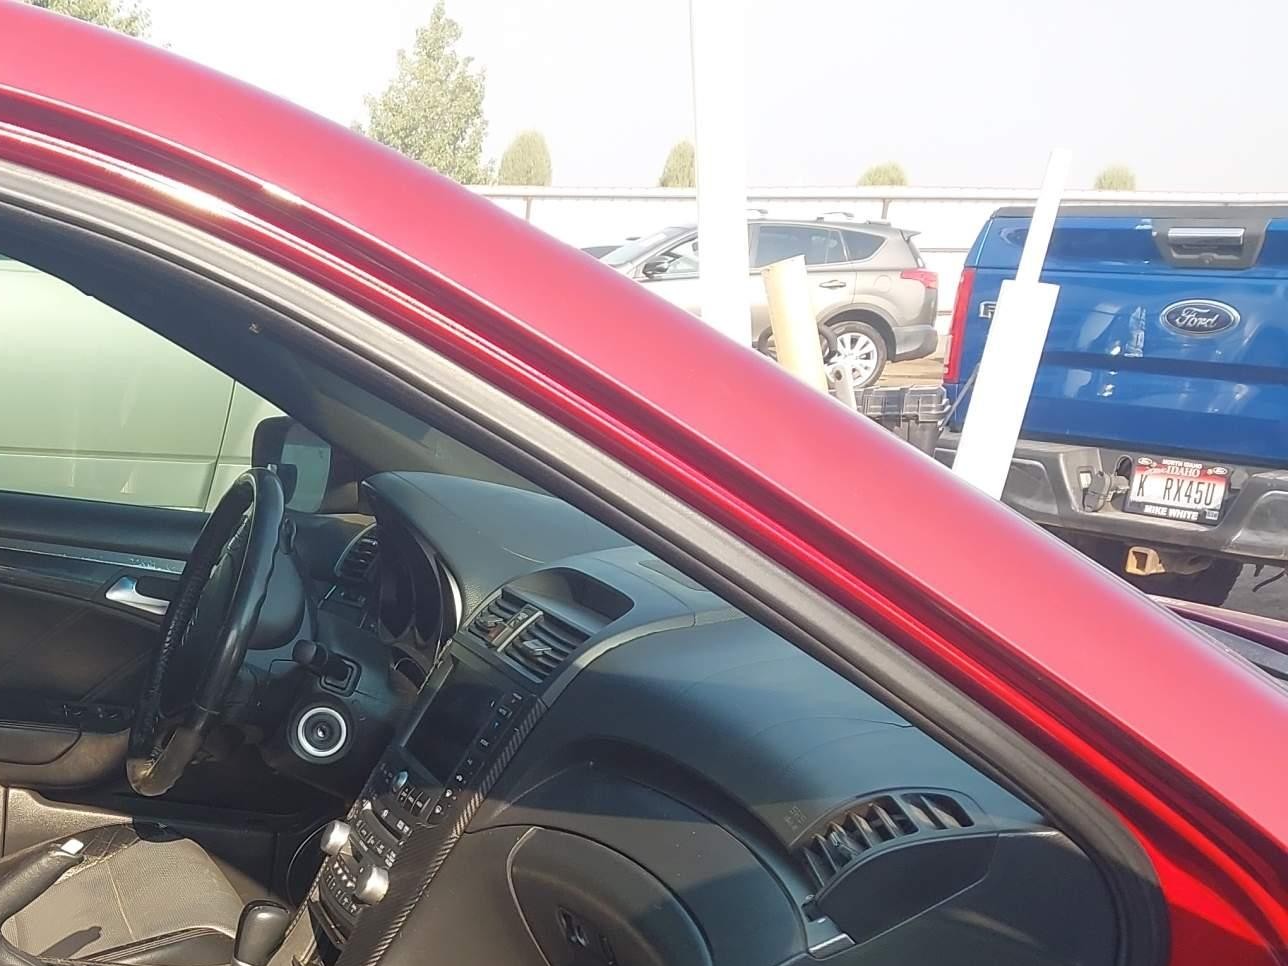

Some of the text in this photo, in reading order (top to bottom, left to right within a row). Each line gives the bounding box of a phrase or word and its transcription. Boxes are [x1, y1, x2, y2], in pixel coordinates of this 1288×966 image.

[1176, 307, 1219, 328] Ford
[1166, 466, 1200, 477] IDAHO
[1137, 474, 1147, 496] K
[1144, 505, 1168, 515] MIKE
[1169, 508, 1199, 520] WHITE
